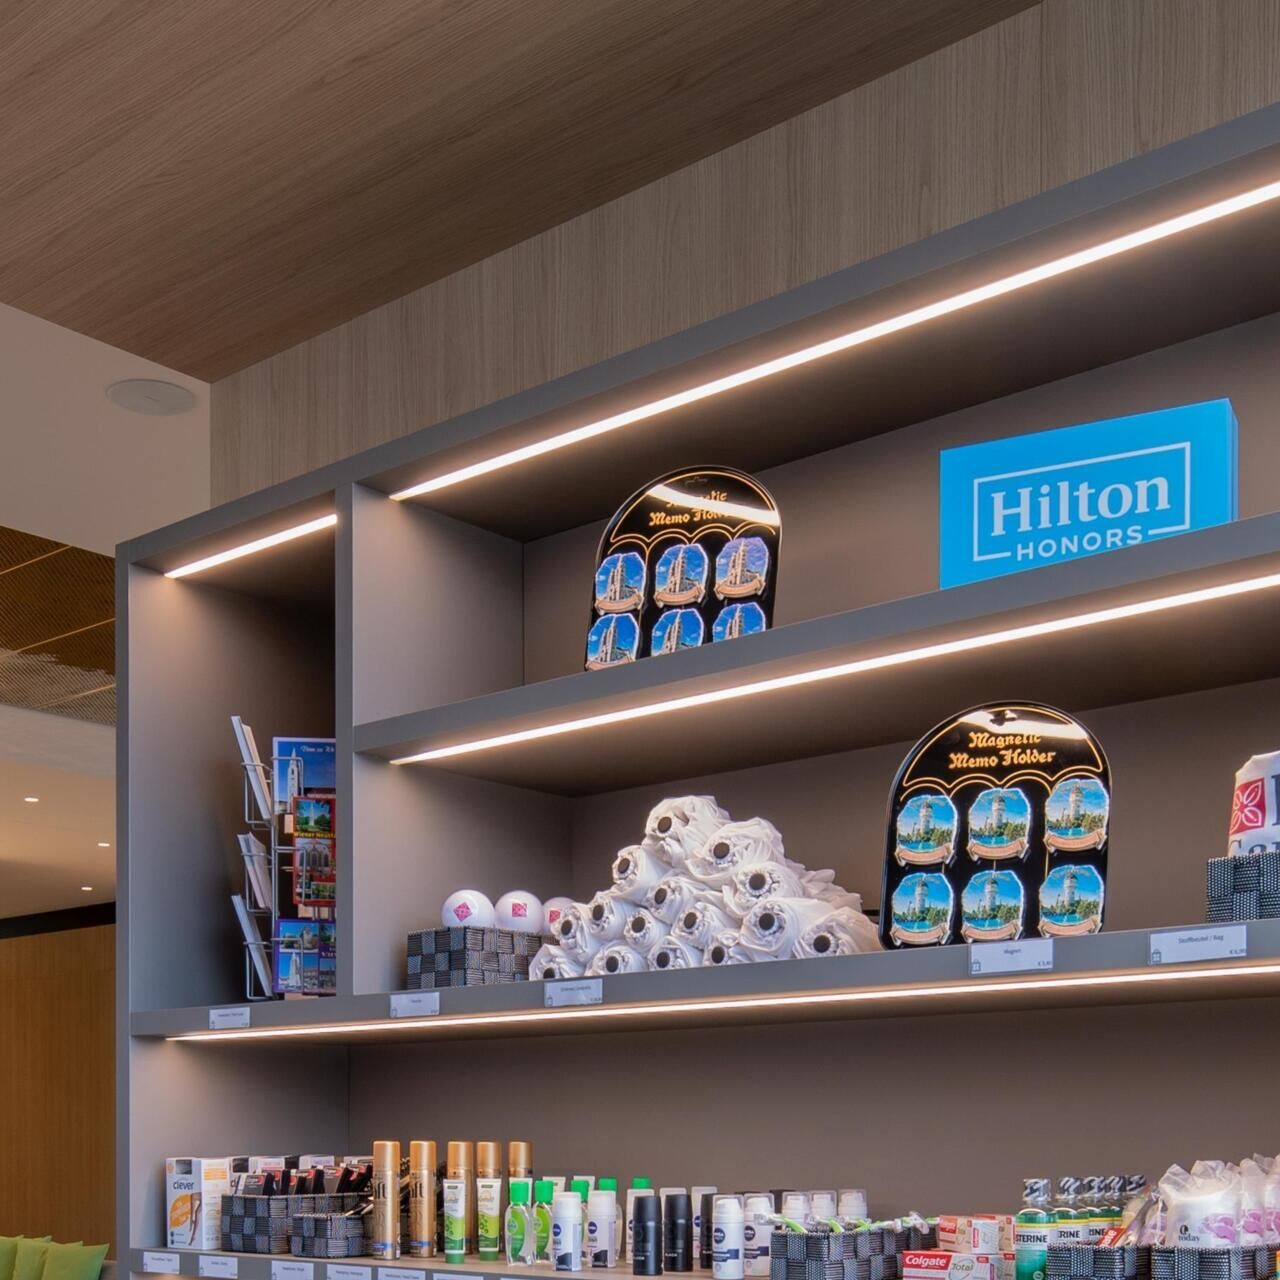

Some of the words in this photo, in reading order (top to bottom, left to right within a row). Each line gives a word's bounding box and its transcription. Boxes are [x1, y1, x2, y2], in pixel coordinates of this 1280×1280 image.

[991, 476, 1171, 537] Hilton
[648, 511, 690, 526] Memo
[1017, 525, 1143, 561] HONORS
[968, 731, 1042, 749] Magnetic
[948, 752, 999, 769] Memo
[999, 748, 1057, 768] Holder
[172, 1180, 196, 1191] clever
[1178, 1232, 1201, 1243] today
[905, 1254, 947, 1268] Colgate
[952, 1262, 974, 1272] Total
